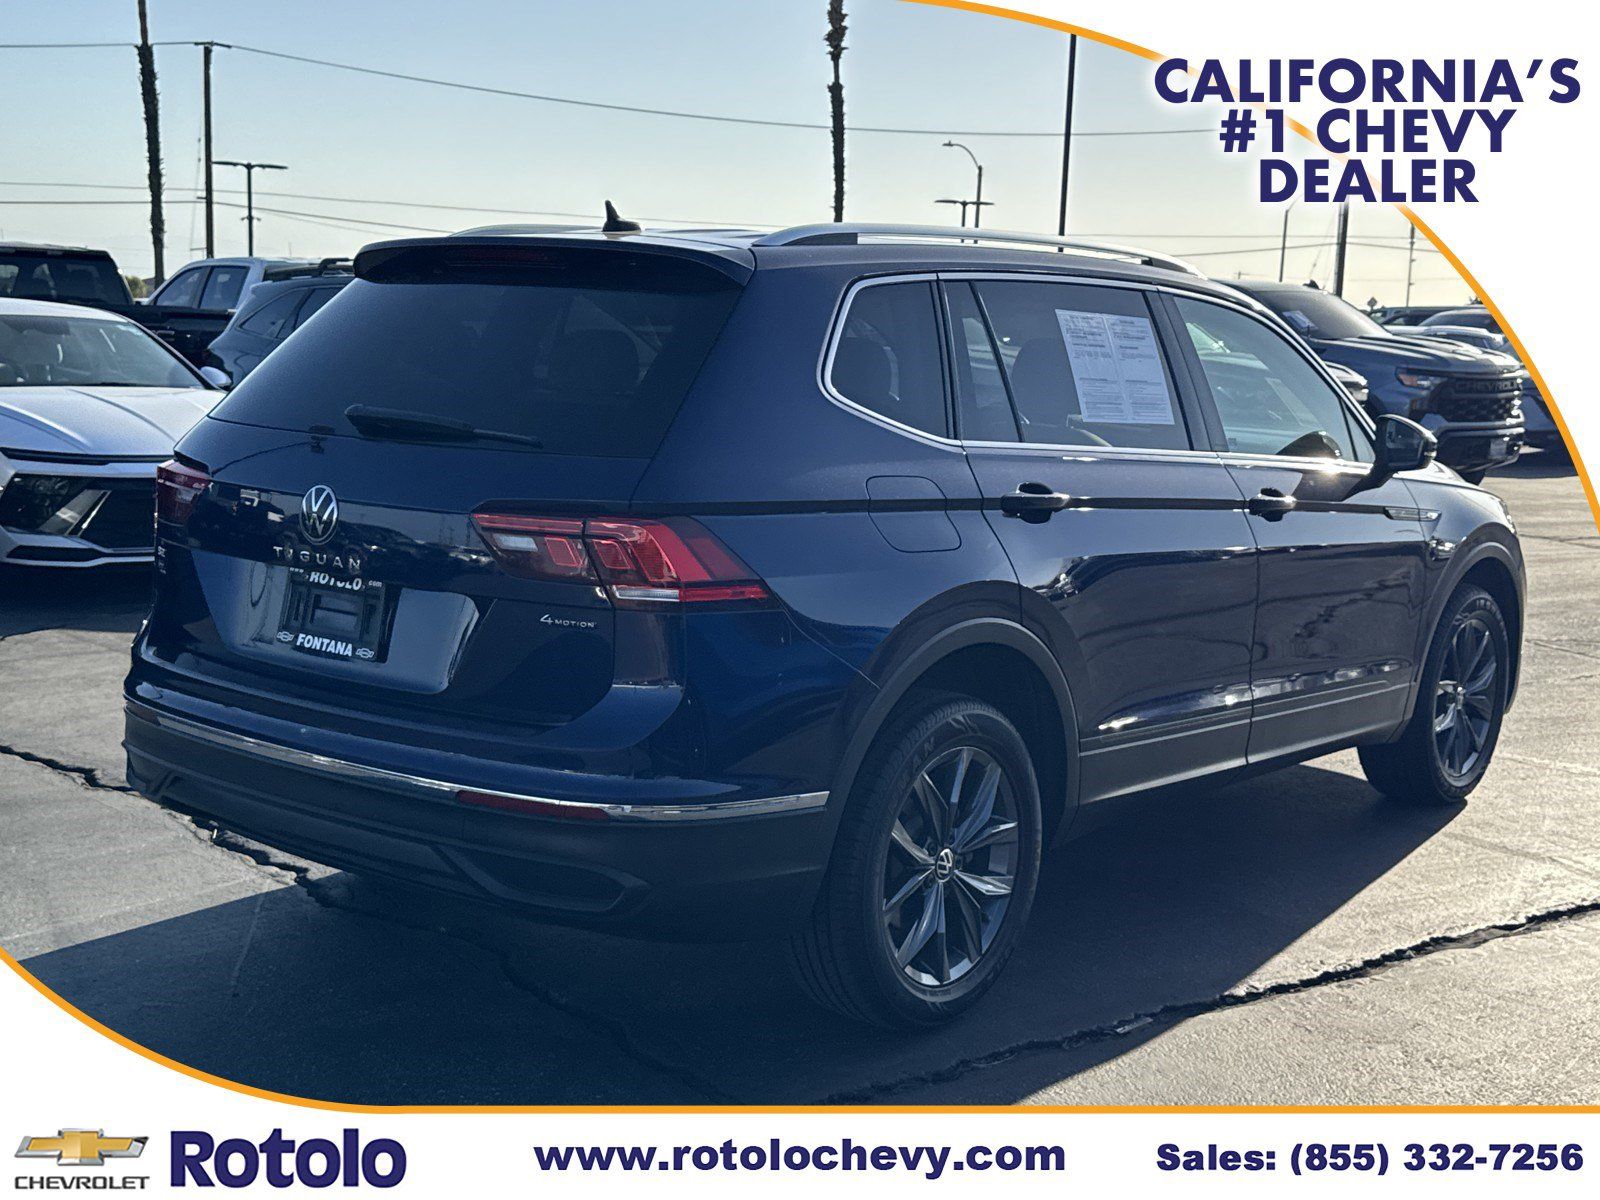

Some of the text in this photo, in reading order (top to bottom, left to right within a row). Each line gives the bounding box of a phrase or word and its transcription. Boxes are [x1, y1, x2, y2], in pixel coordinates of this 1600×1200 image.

[273, 545, 361, 574] TIGUAN
[539, 613, 595, 628] 4MOTION
[296, 633, 353, 657] FONTANA
